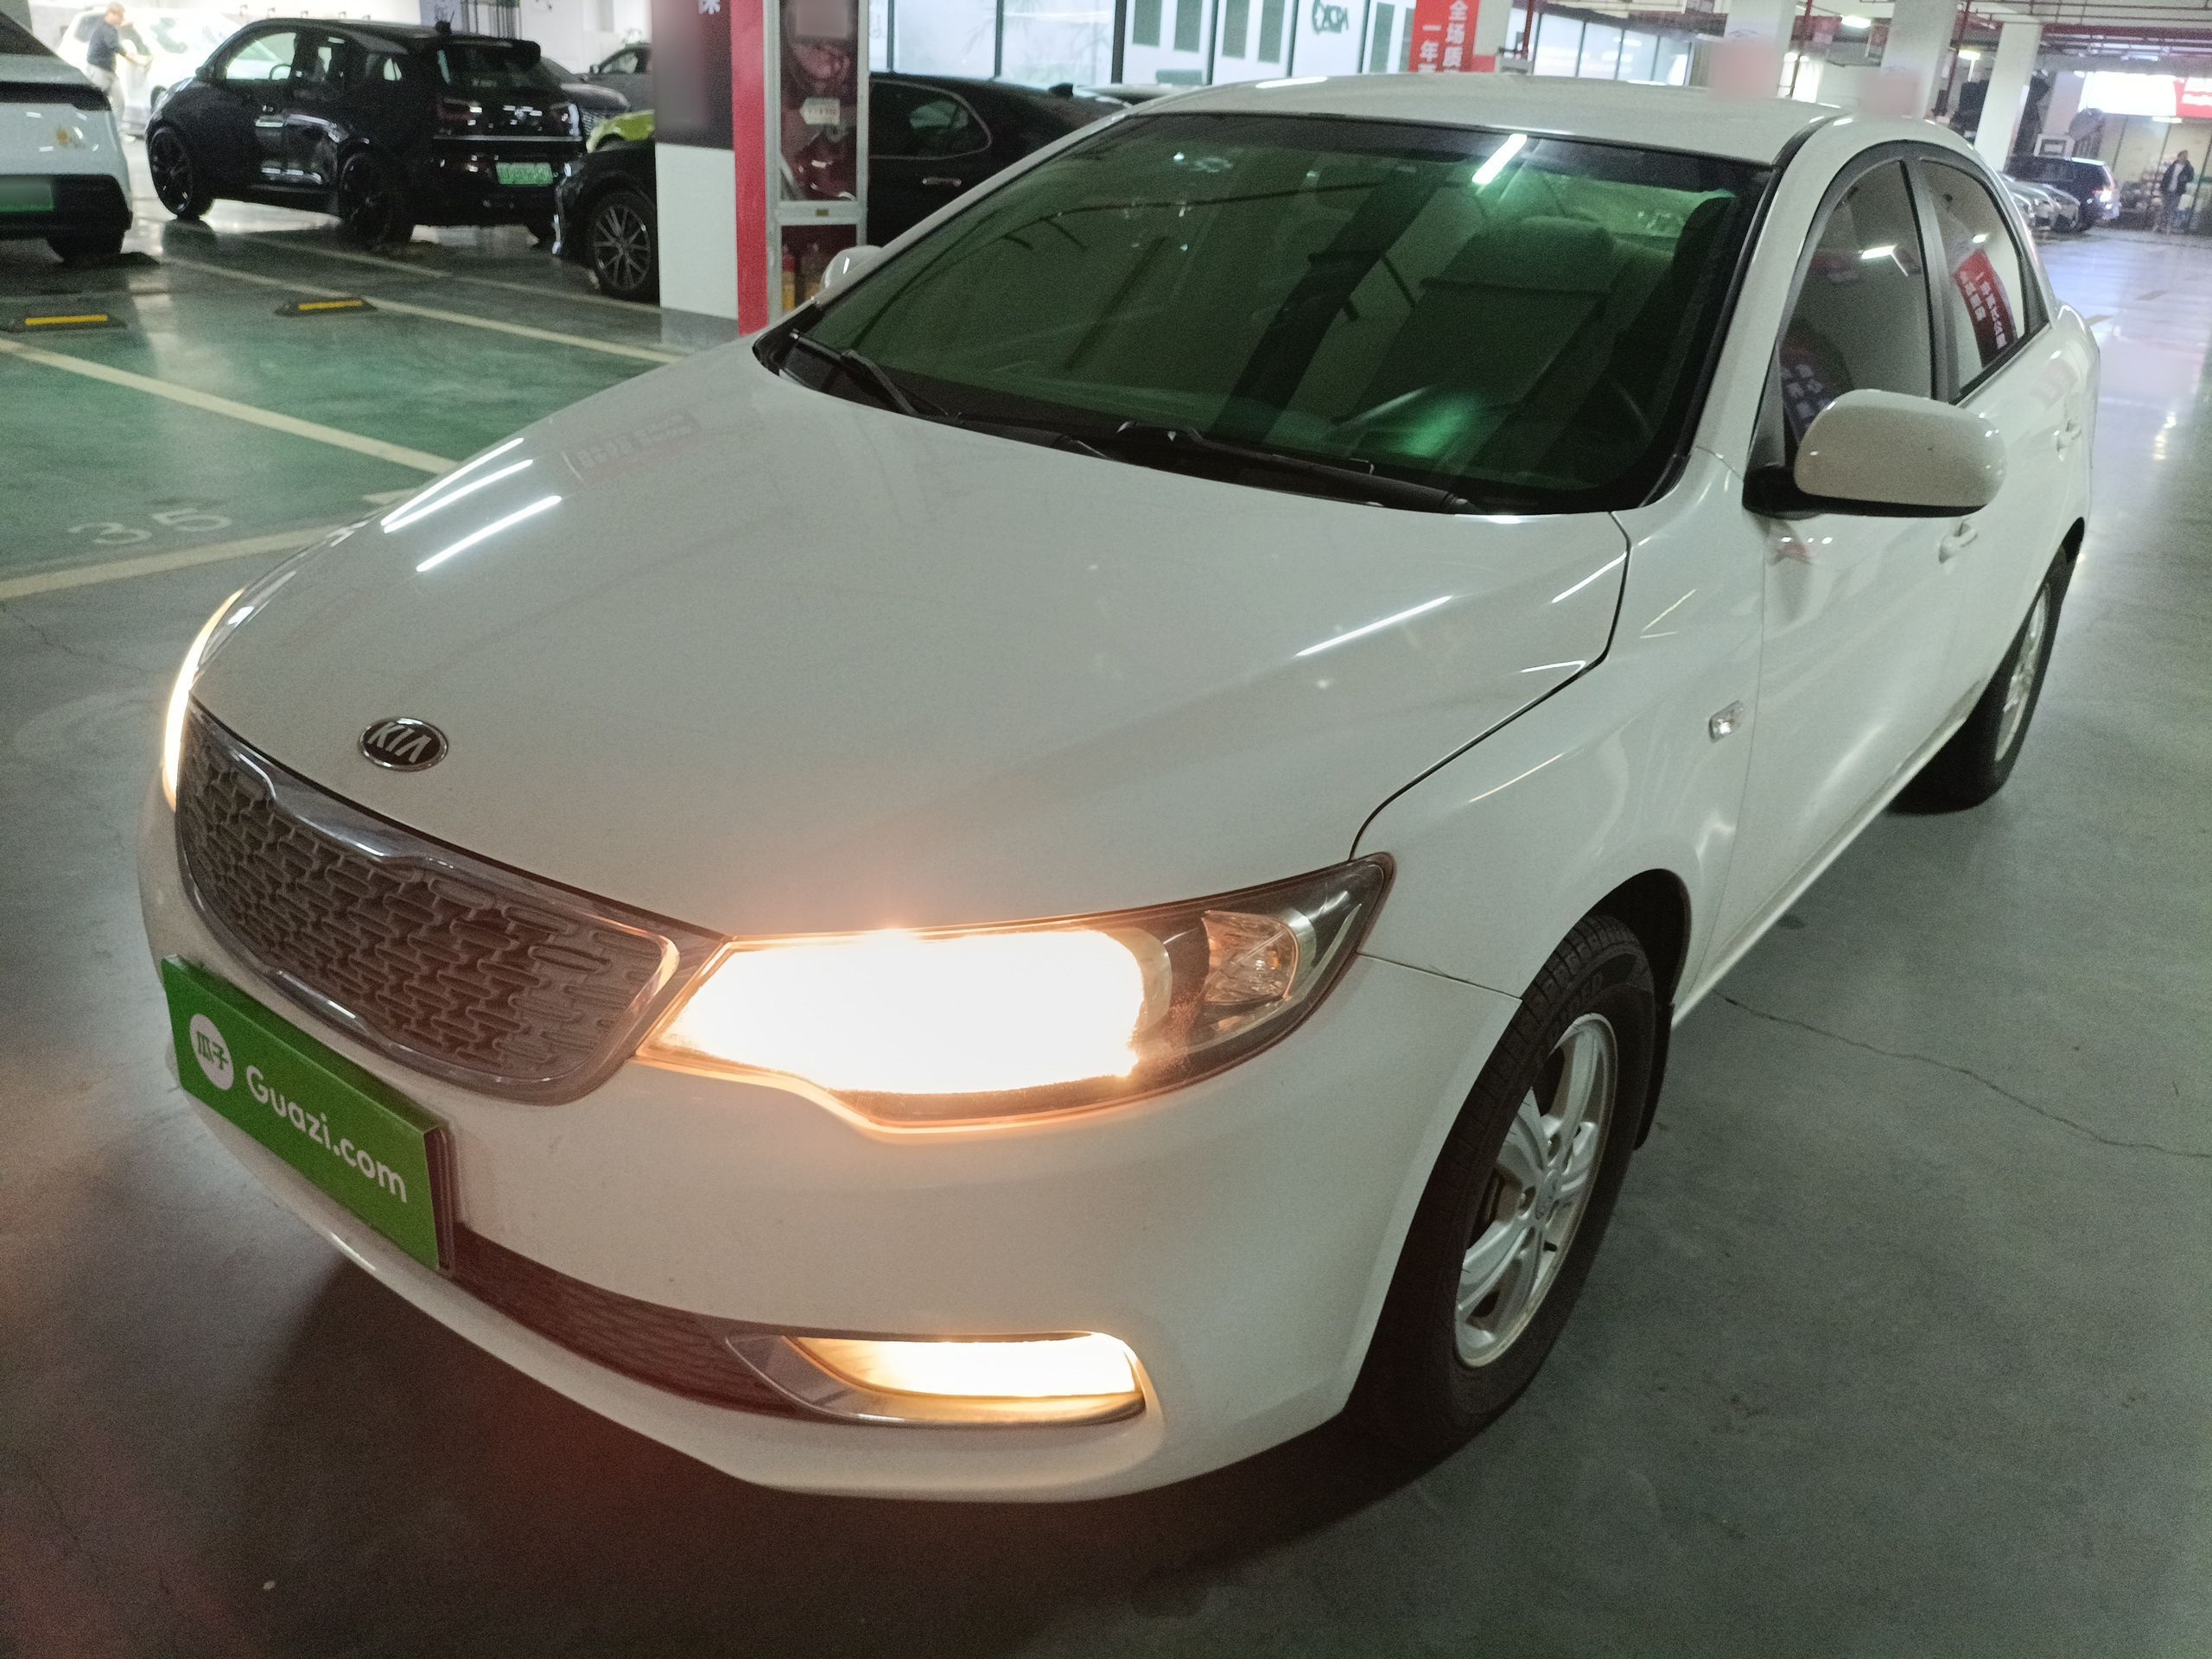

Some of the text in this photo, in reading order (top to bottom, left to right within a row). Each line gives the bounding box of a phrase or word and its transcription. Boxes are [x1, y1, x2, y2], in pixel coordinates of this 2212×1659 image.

[1442, 0, 1468, 73] 全场质
[67, 507, 233, 544] 35
[367, 721, 432, 764] KIA
[197, 1031, 229, 1071] 瓜子
[245, 1065, 407, 1204] Guazi.com
